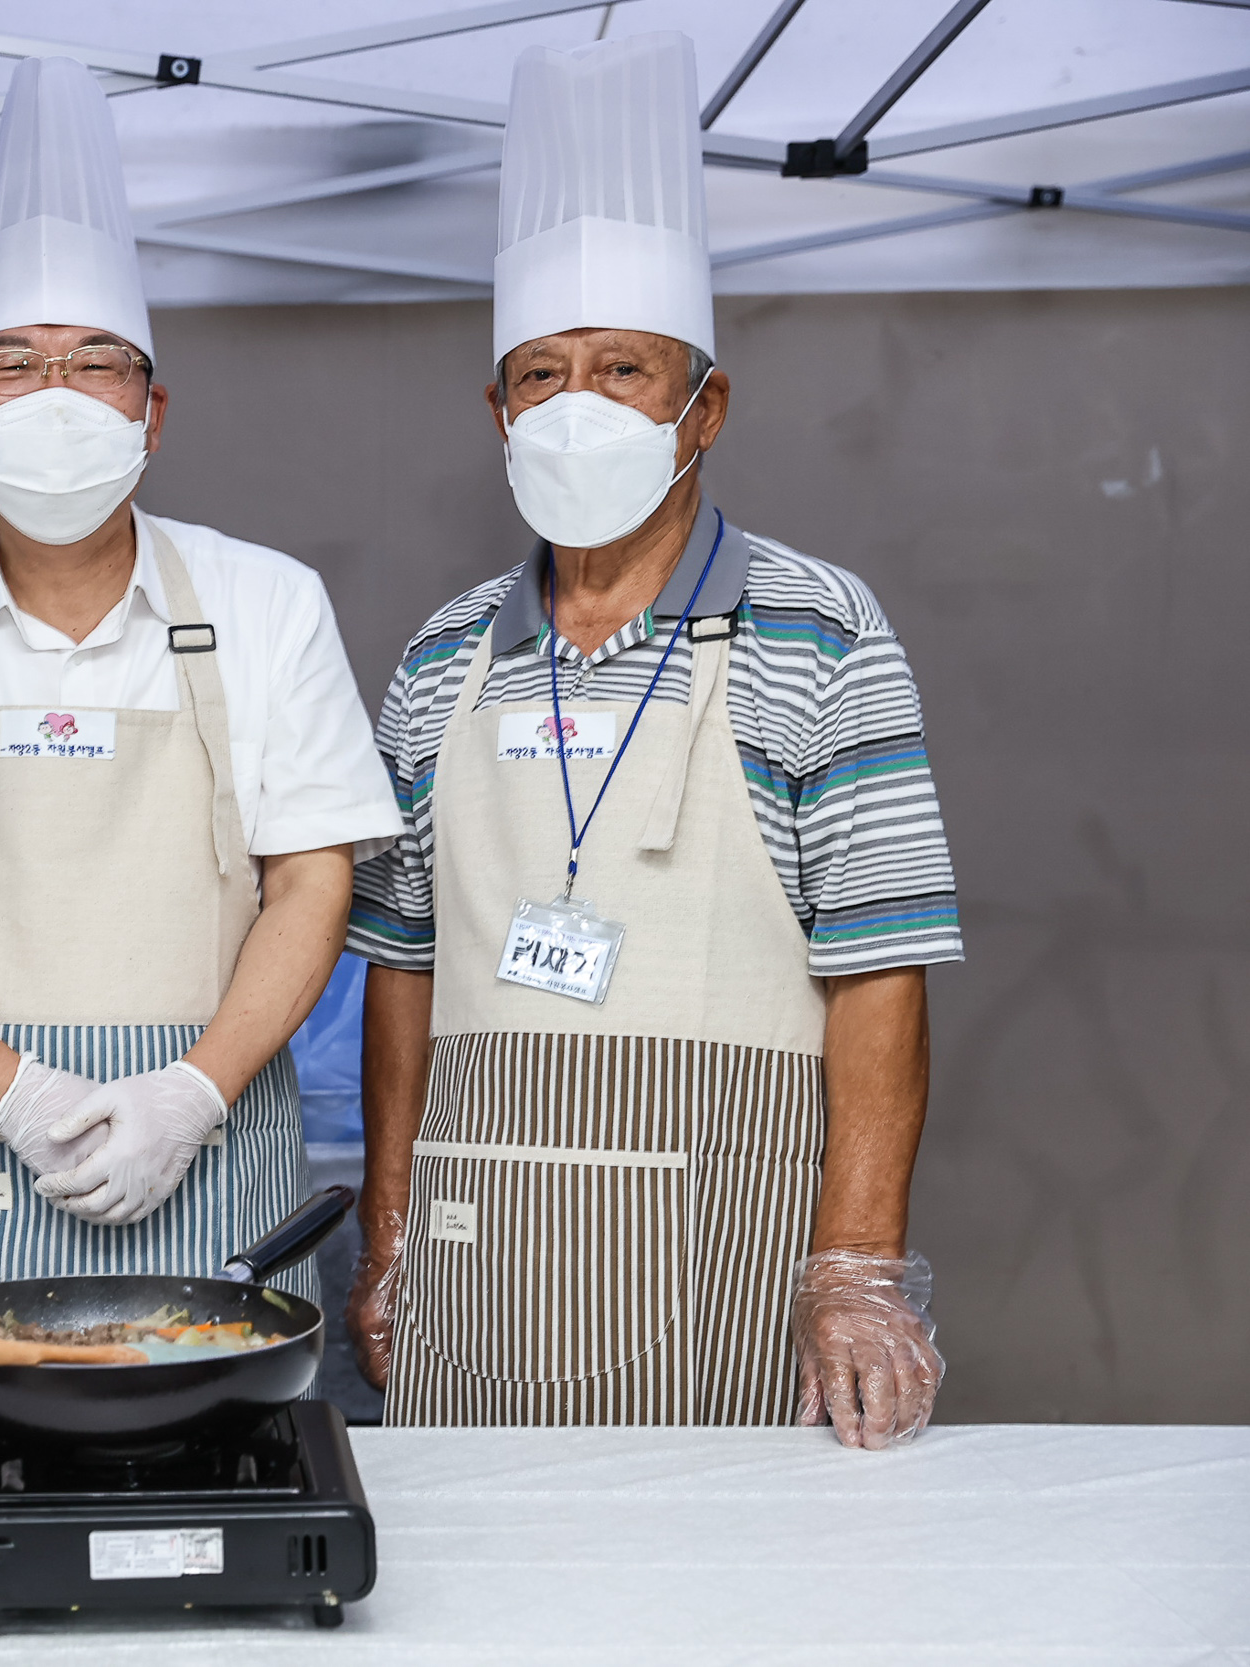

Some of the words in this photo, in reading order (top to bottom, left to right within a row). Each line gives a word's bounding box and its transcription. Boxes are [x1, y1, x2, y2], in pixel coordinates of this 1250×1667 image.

[8, 744, 41, 757] 자양2동
[46, 744, 105, 758] 자원봉사캠프
[505, 747, 538, 759] 자양2동
